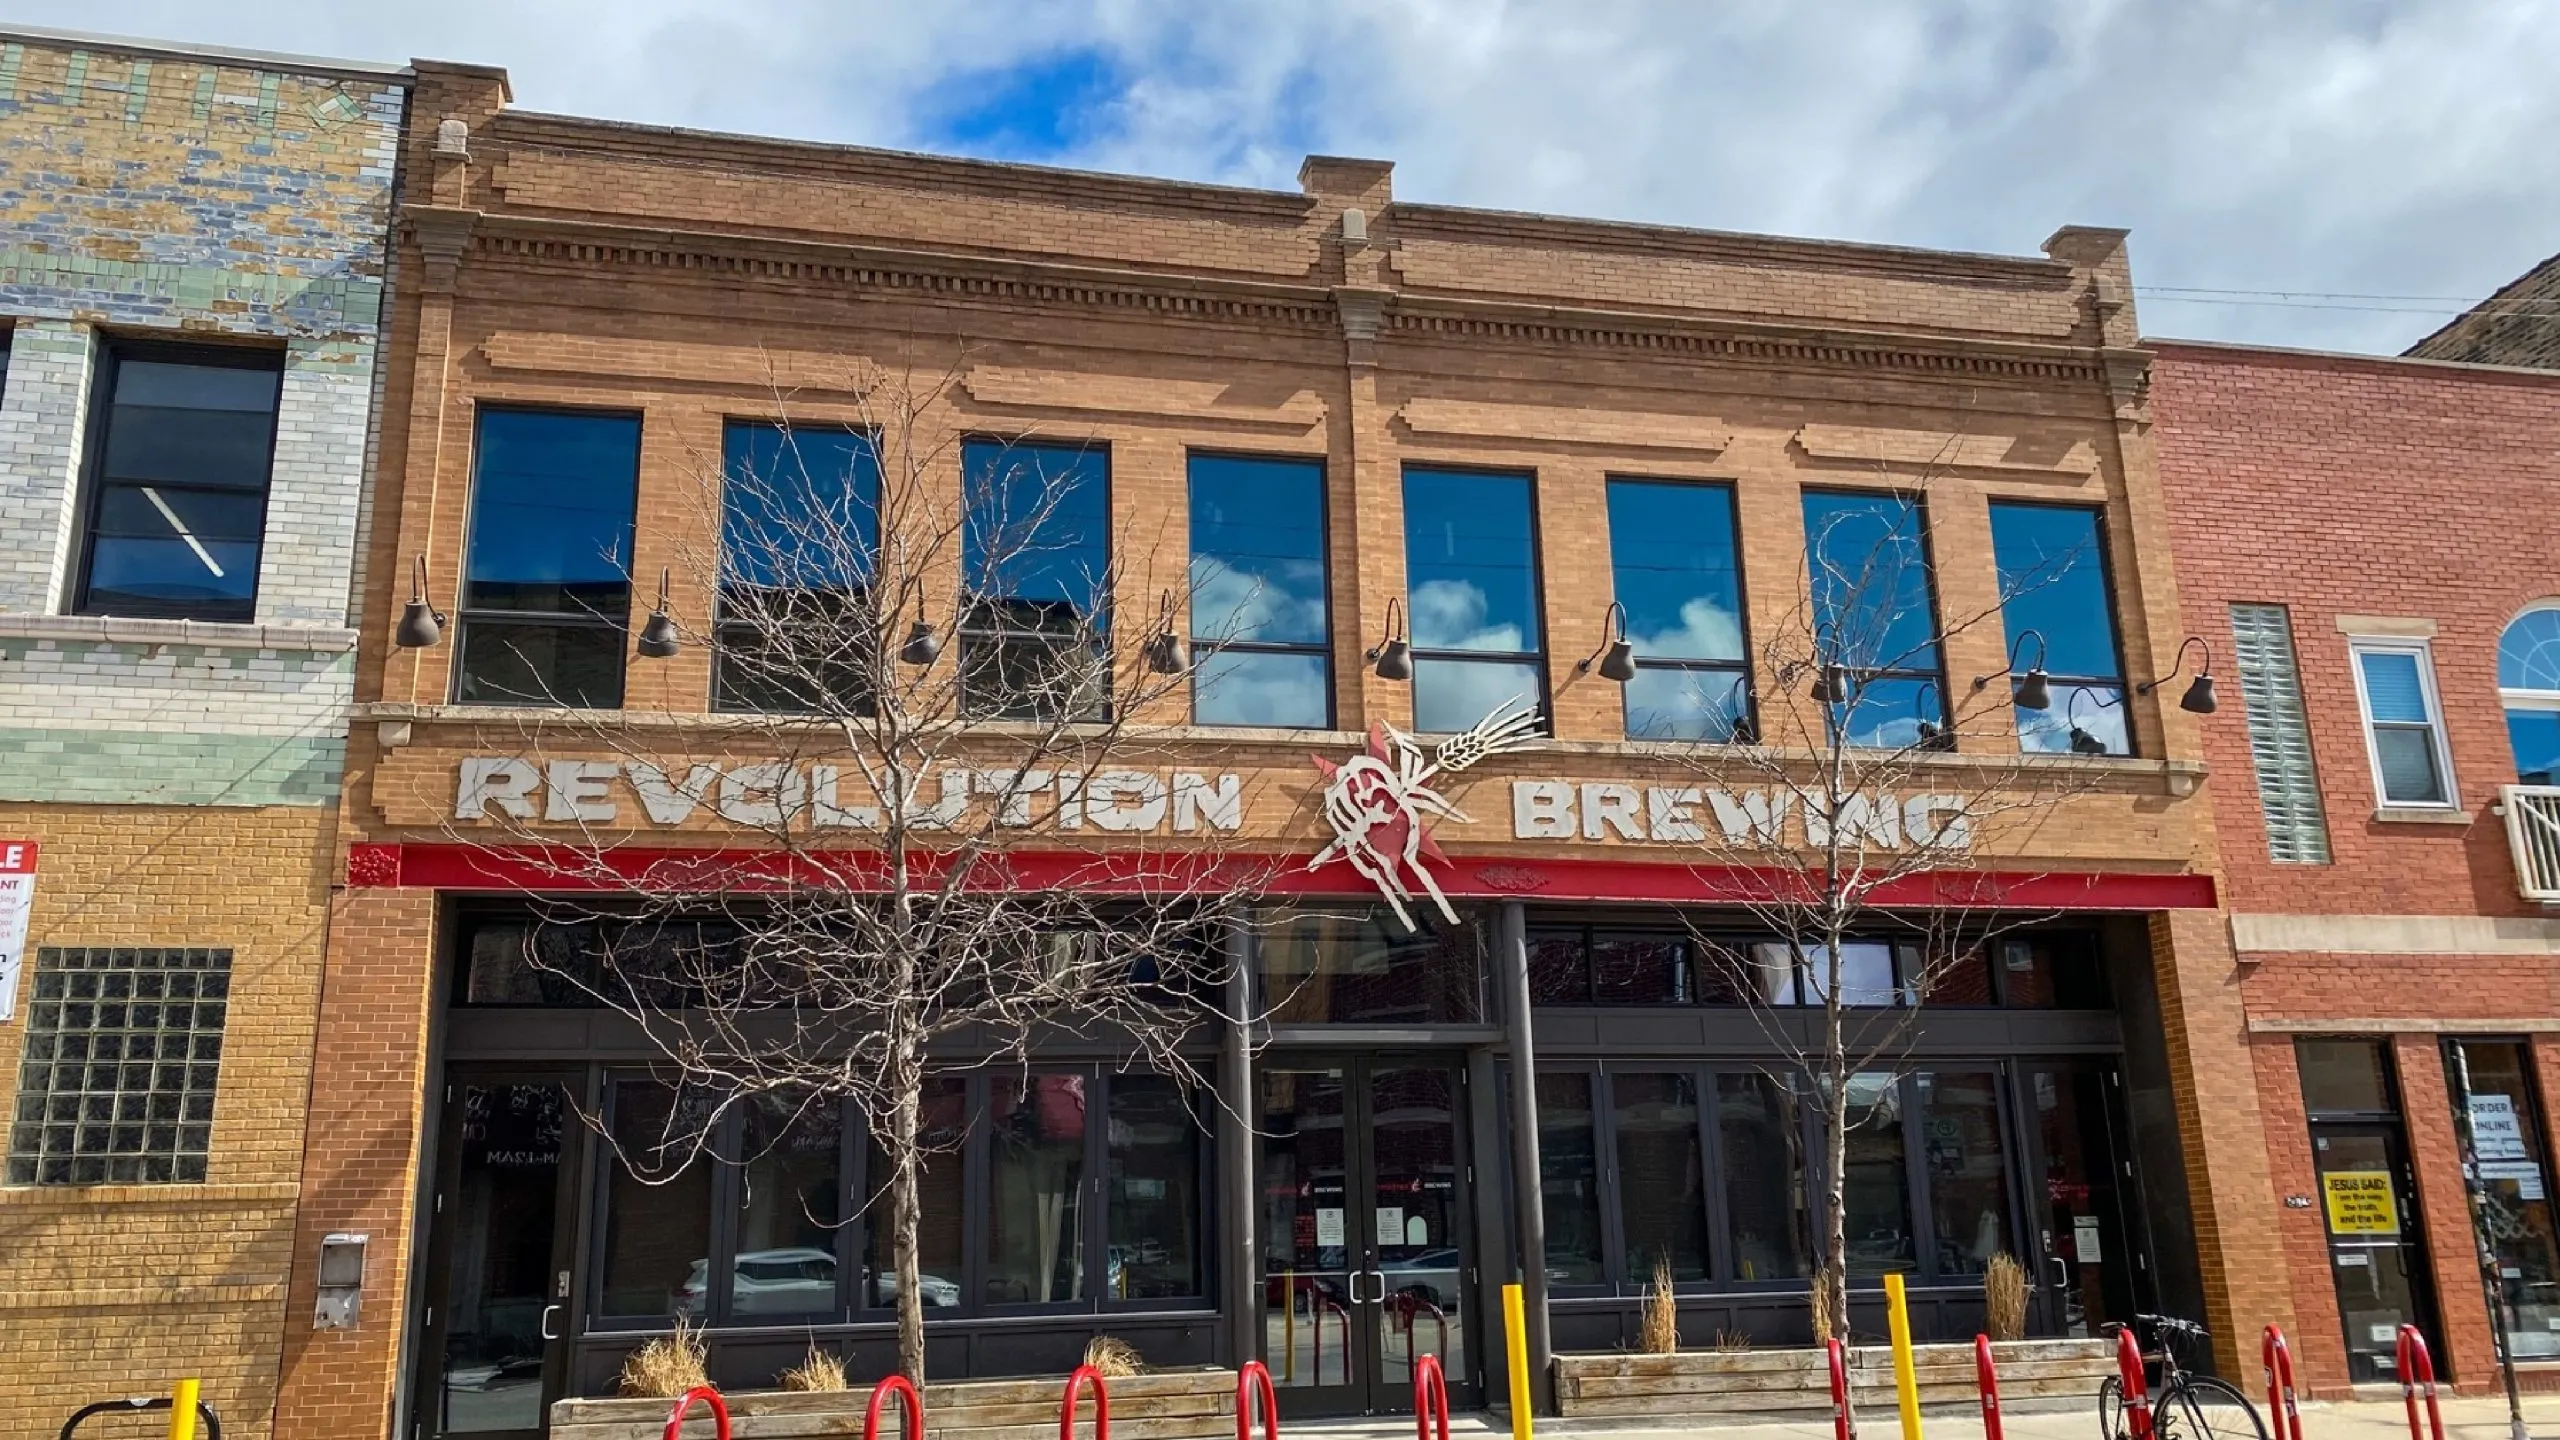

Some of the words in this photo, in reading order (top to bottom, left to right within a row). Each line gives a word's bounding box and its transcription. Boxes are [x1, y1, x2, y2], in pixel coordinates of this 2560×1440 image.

[454, 757, 1242, 832] REVOLUTION
[1512, 780, 1971, 849] BREWING
[2328, 1178, 2359, 1191] JESUS
